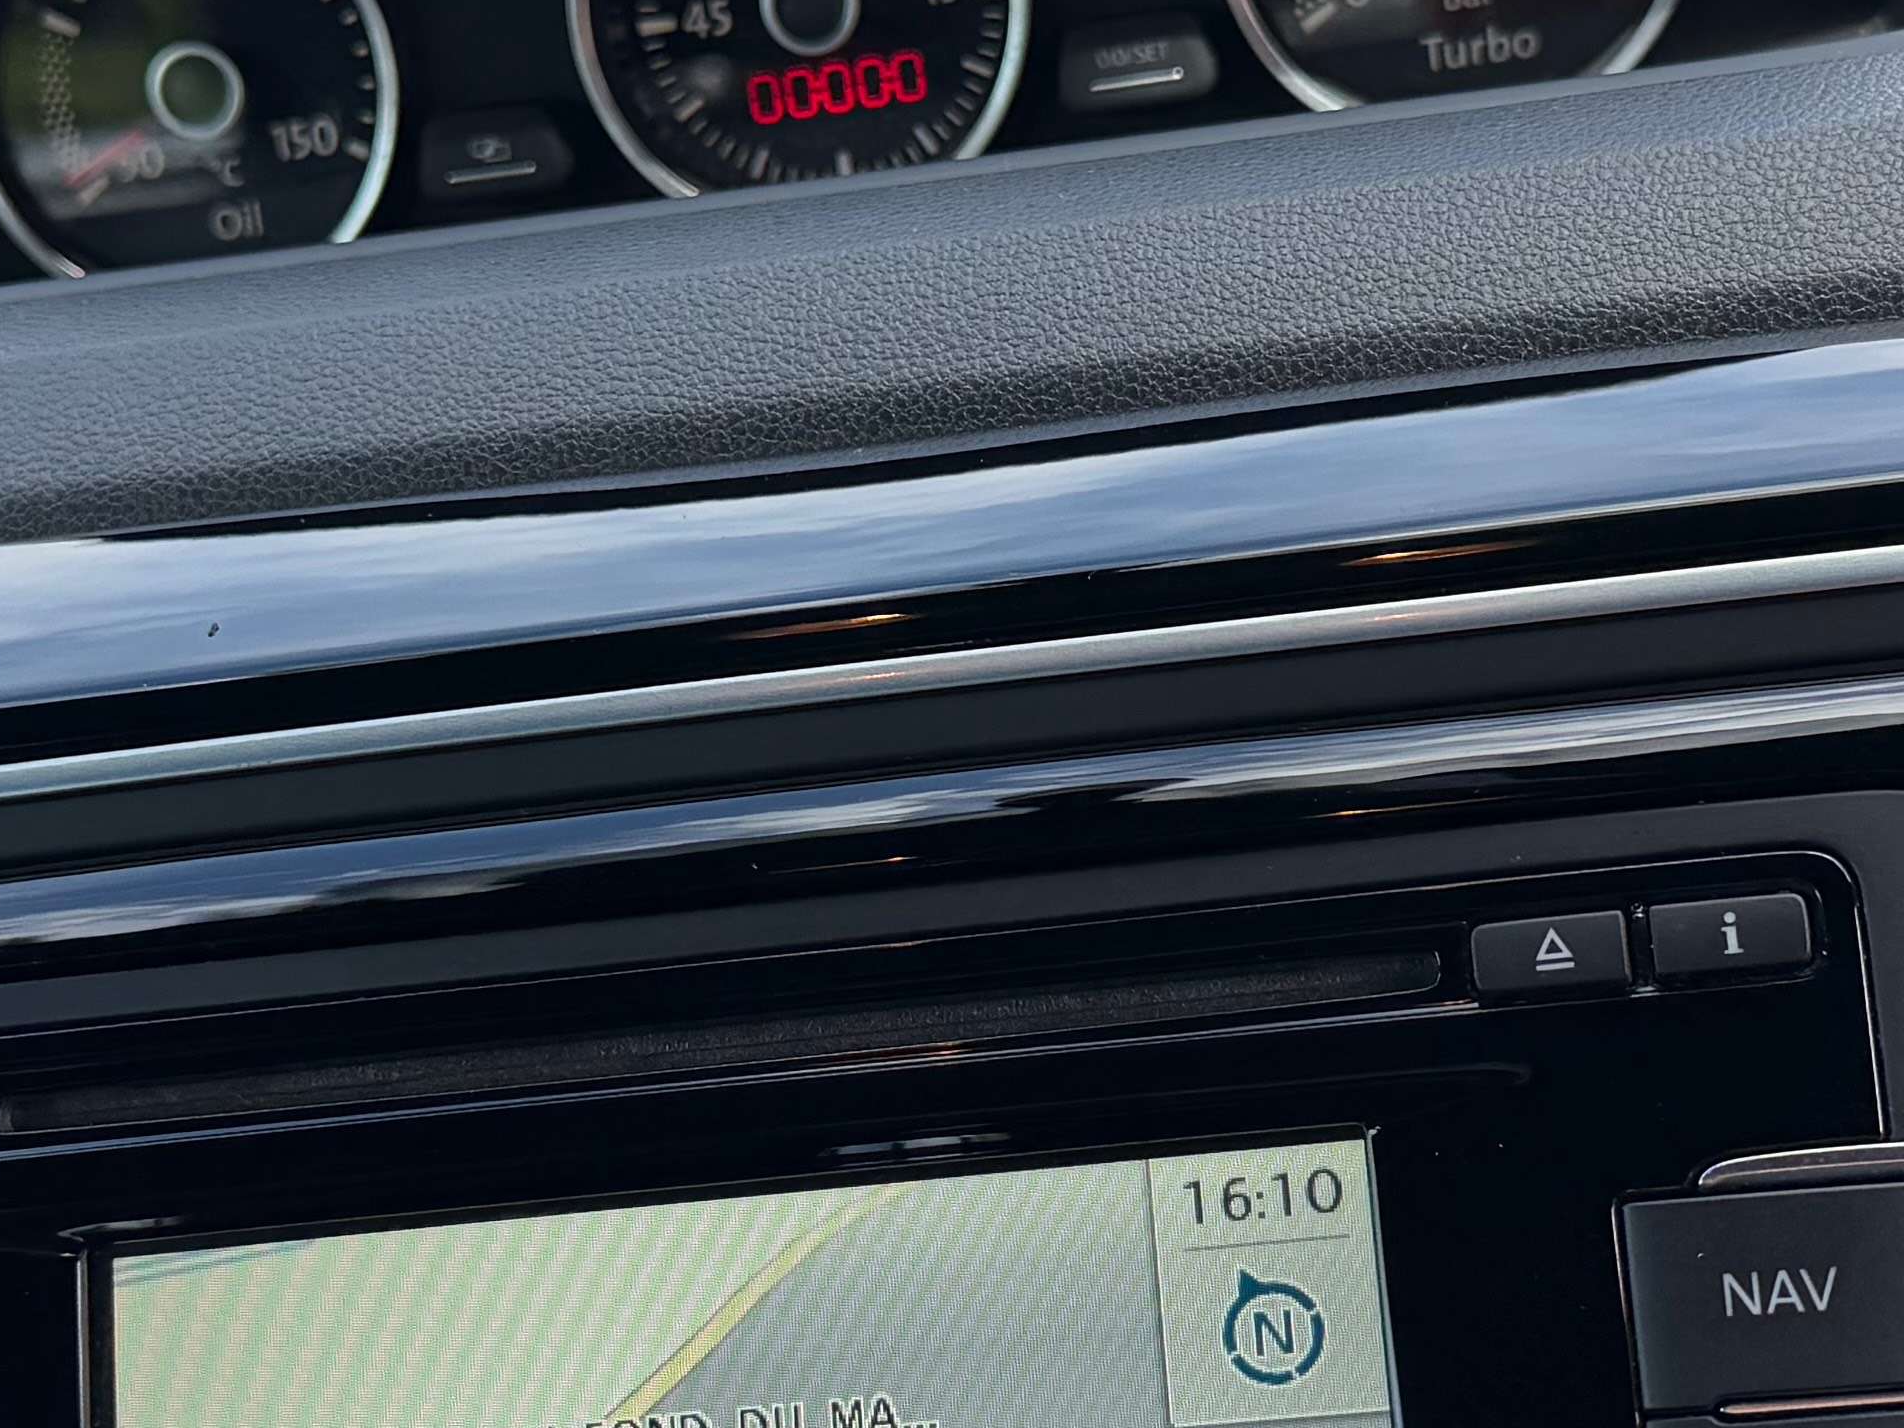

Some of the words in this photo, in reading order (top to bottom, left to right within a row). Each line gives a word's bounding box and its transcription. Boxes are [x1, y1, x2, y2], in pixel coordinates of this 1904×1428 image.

[1420, 24, 1539, 72] Turbo
[270, 117, 339, 162] 150
[214, 200, 262, 241] Oil
[1182, 1167, 1344, 1226] 16:10
[1721, 1267, 1838, 1316] NAV
